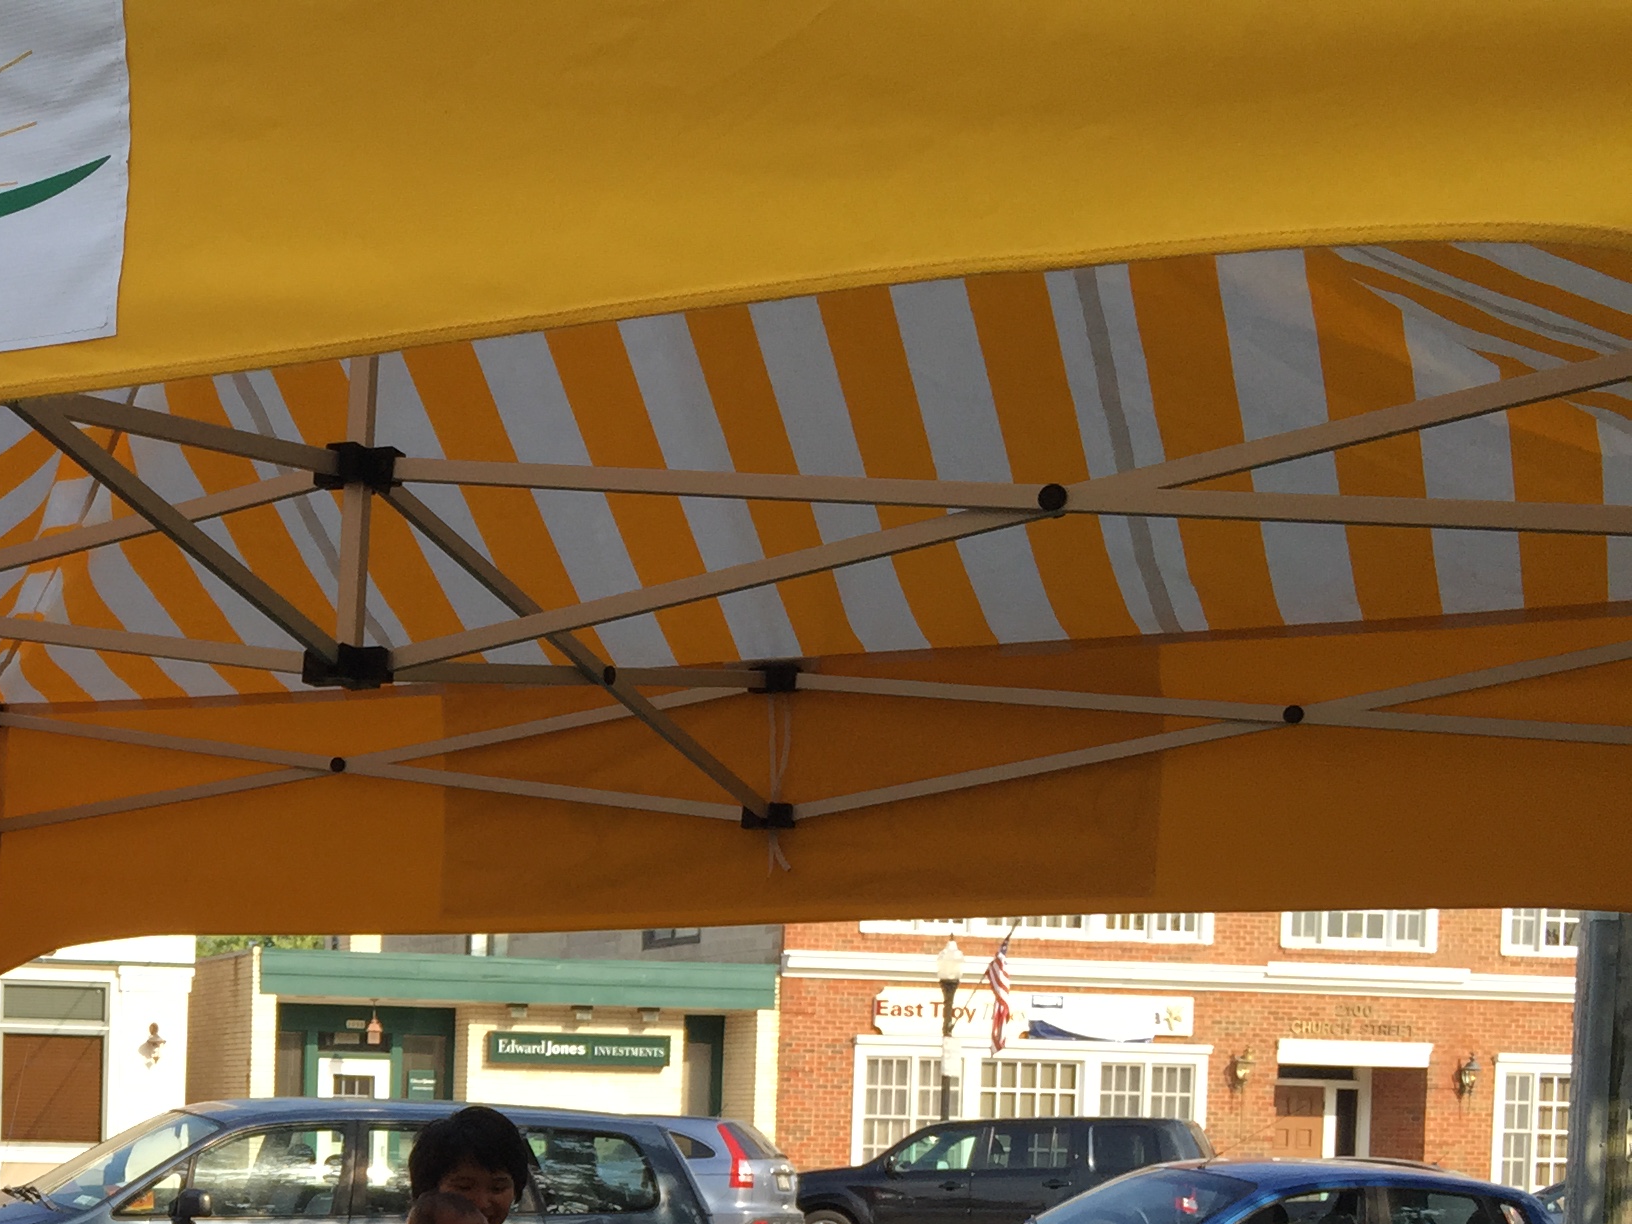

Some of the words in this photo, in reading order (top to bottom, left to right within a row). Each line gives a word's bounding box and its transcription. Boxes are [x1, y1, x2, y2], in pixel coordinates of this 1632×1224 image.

[876, 1000, 924, 1018] East
[930, 1002, 976, 1024] Toy
[1289, 1020, 1351, 1035] CHURCH
[1360, 1023, 1412, 1037] STREET
[594, 1046, 665, 1058] INVESTMENTS
